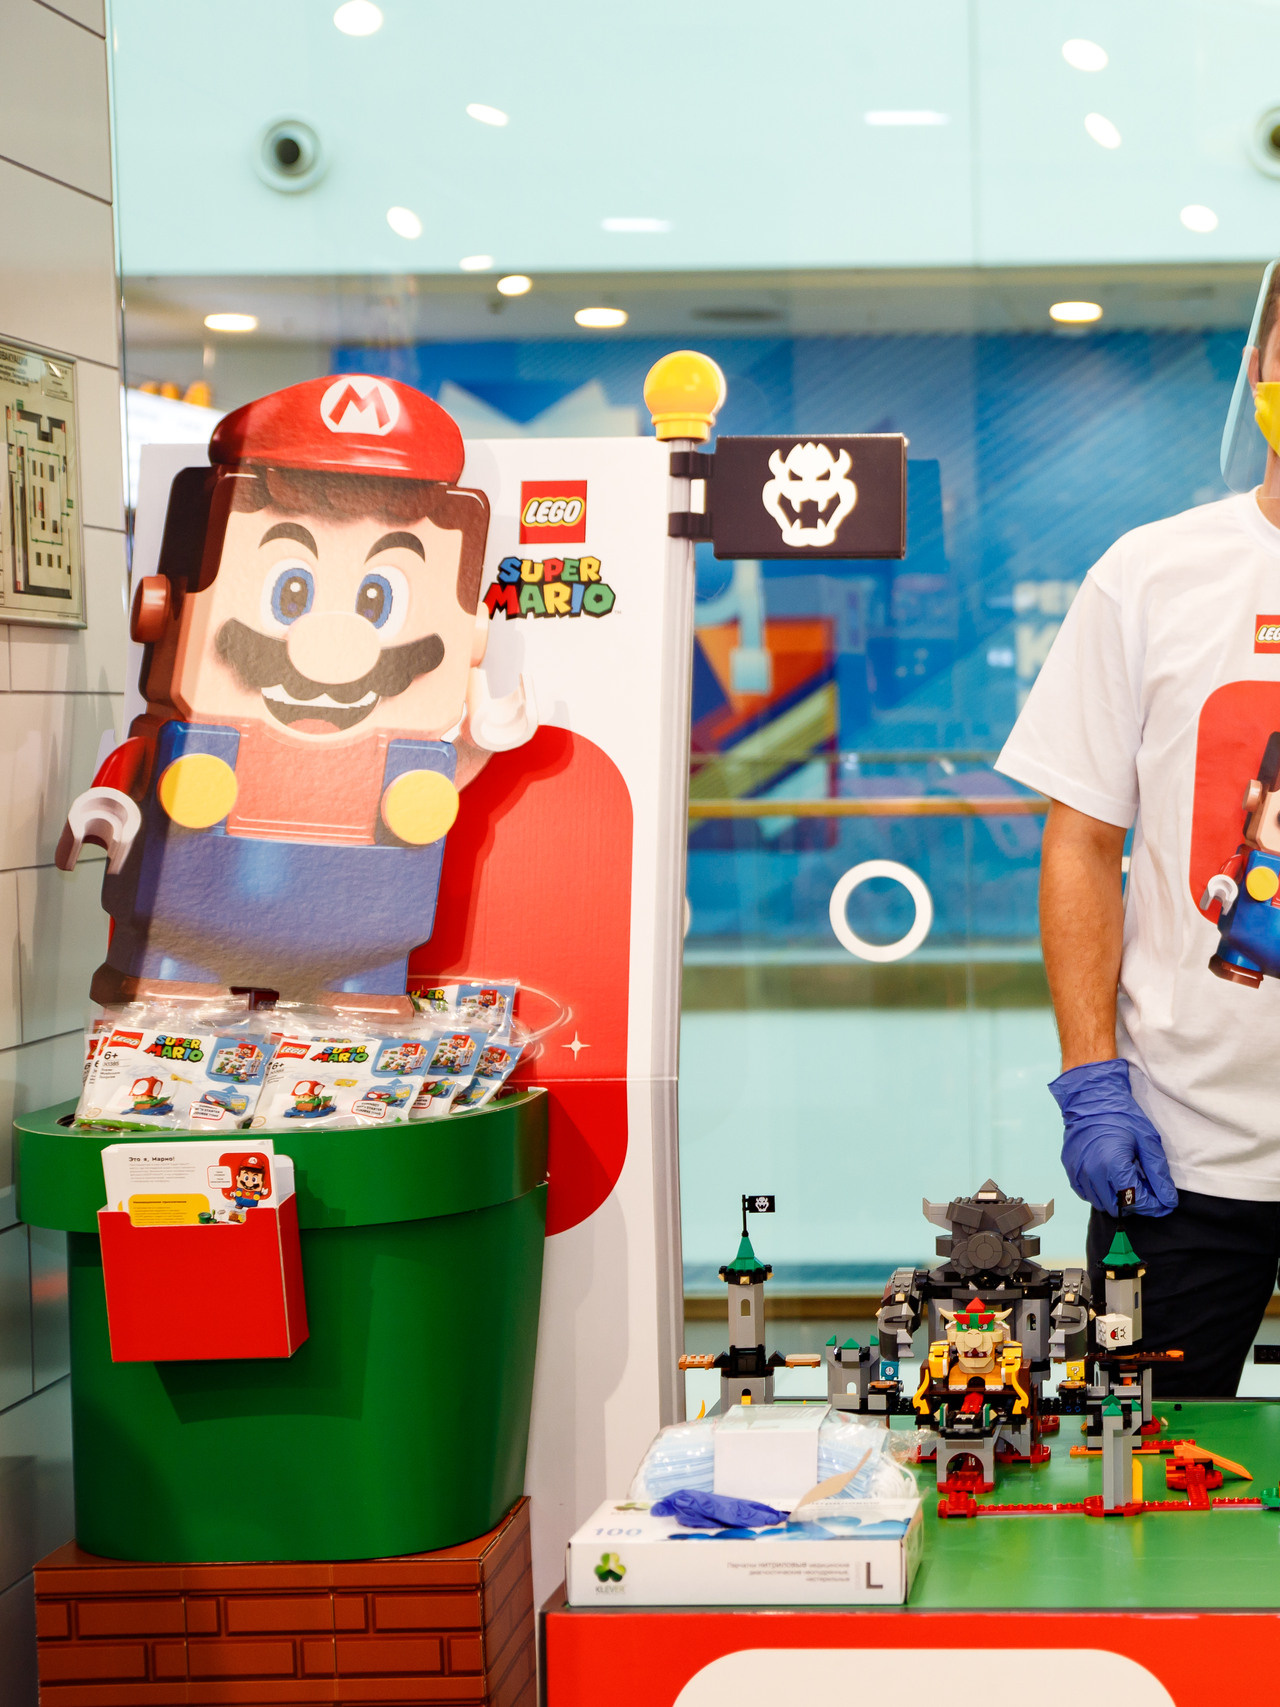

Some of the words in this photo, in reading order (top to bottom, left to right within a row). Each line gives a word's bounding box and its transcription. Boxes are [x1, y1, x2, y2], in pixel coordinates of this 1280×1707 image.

[328, 383, 390, 429] M
[523, 497, 585, 526] LEGO
[497, 556, 602, 583] SUPER
[483, 582, 616, 620] MARIO
[406, 989, 445, 1000] UPER
[111, 1034, 141, 1046] LEGO
[154, 1034, 202, 1049] SUPER
[144, 1043, 204, 1063] MARIO
[280, 1046, 309, 1056] LEGO
[322, 1045, 367, 1054] SUPER
[104, 1051, 119, 1060] 6+
[310, 1052, 369, 1063] MARIO
[272, 1062, 284, 1070] 6+
[595, 1528, 643, 1537] 100
[866, 1562, 883, 1589] L
[595, 1585, 626, 1593] KLEVER
